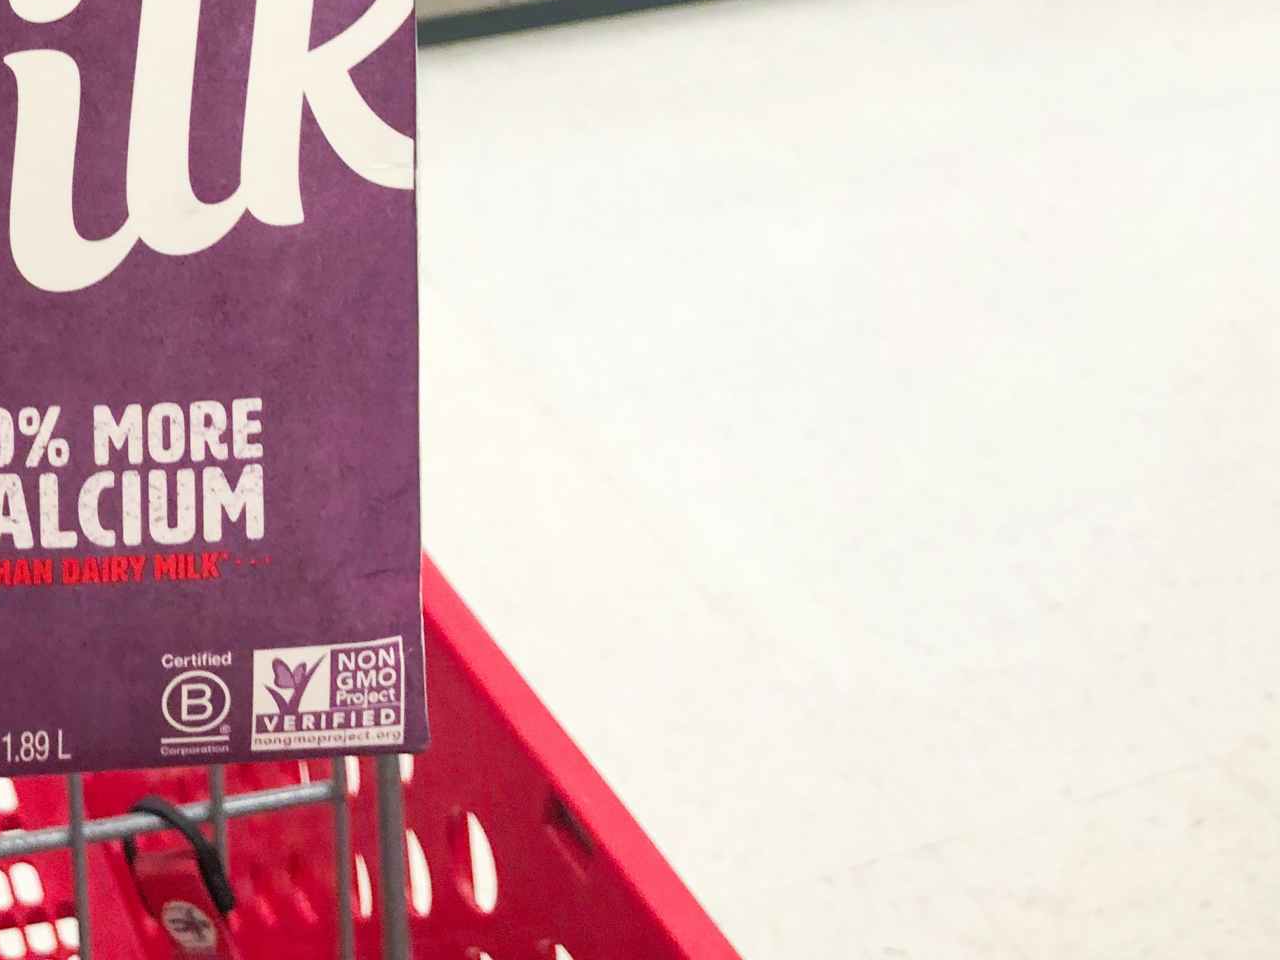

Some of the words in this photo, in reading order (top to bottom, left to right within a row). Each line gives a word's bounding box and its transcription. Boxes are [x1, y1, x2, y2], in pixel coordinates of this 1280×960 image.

[93, 397, 264, 466] MORE
[61, 555, 146, 585] DAIRY
[161, 651, 232, 669] Certified
[336, 648, 397, 672] NON
[336, 667, 398, 690] GMO
[180, 682, 214, 722] B
[335, 688, 397, 708] Project
[263, 707, 397, 733] VERIFIED
[1, 729, 50, 764] 1.89
[58, 728, 72, 760] L
[253, 728, 403, 747] nongmoproject.org
[160, 743, 230, 758] Corporation
